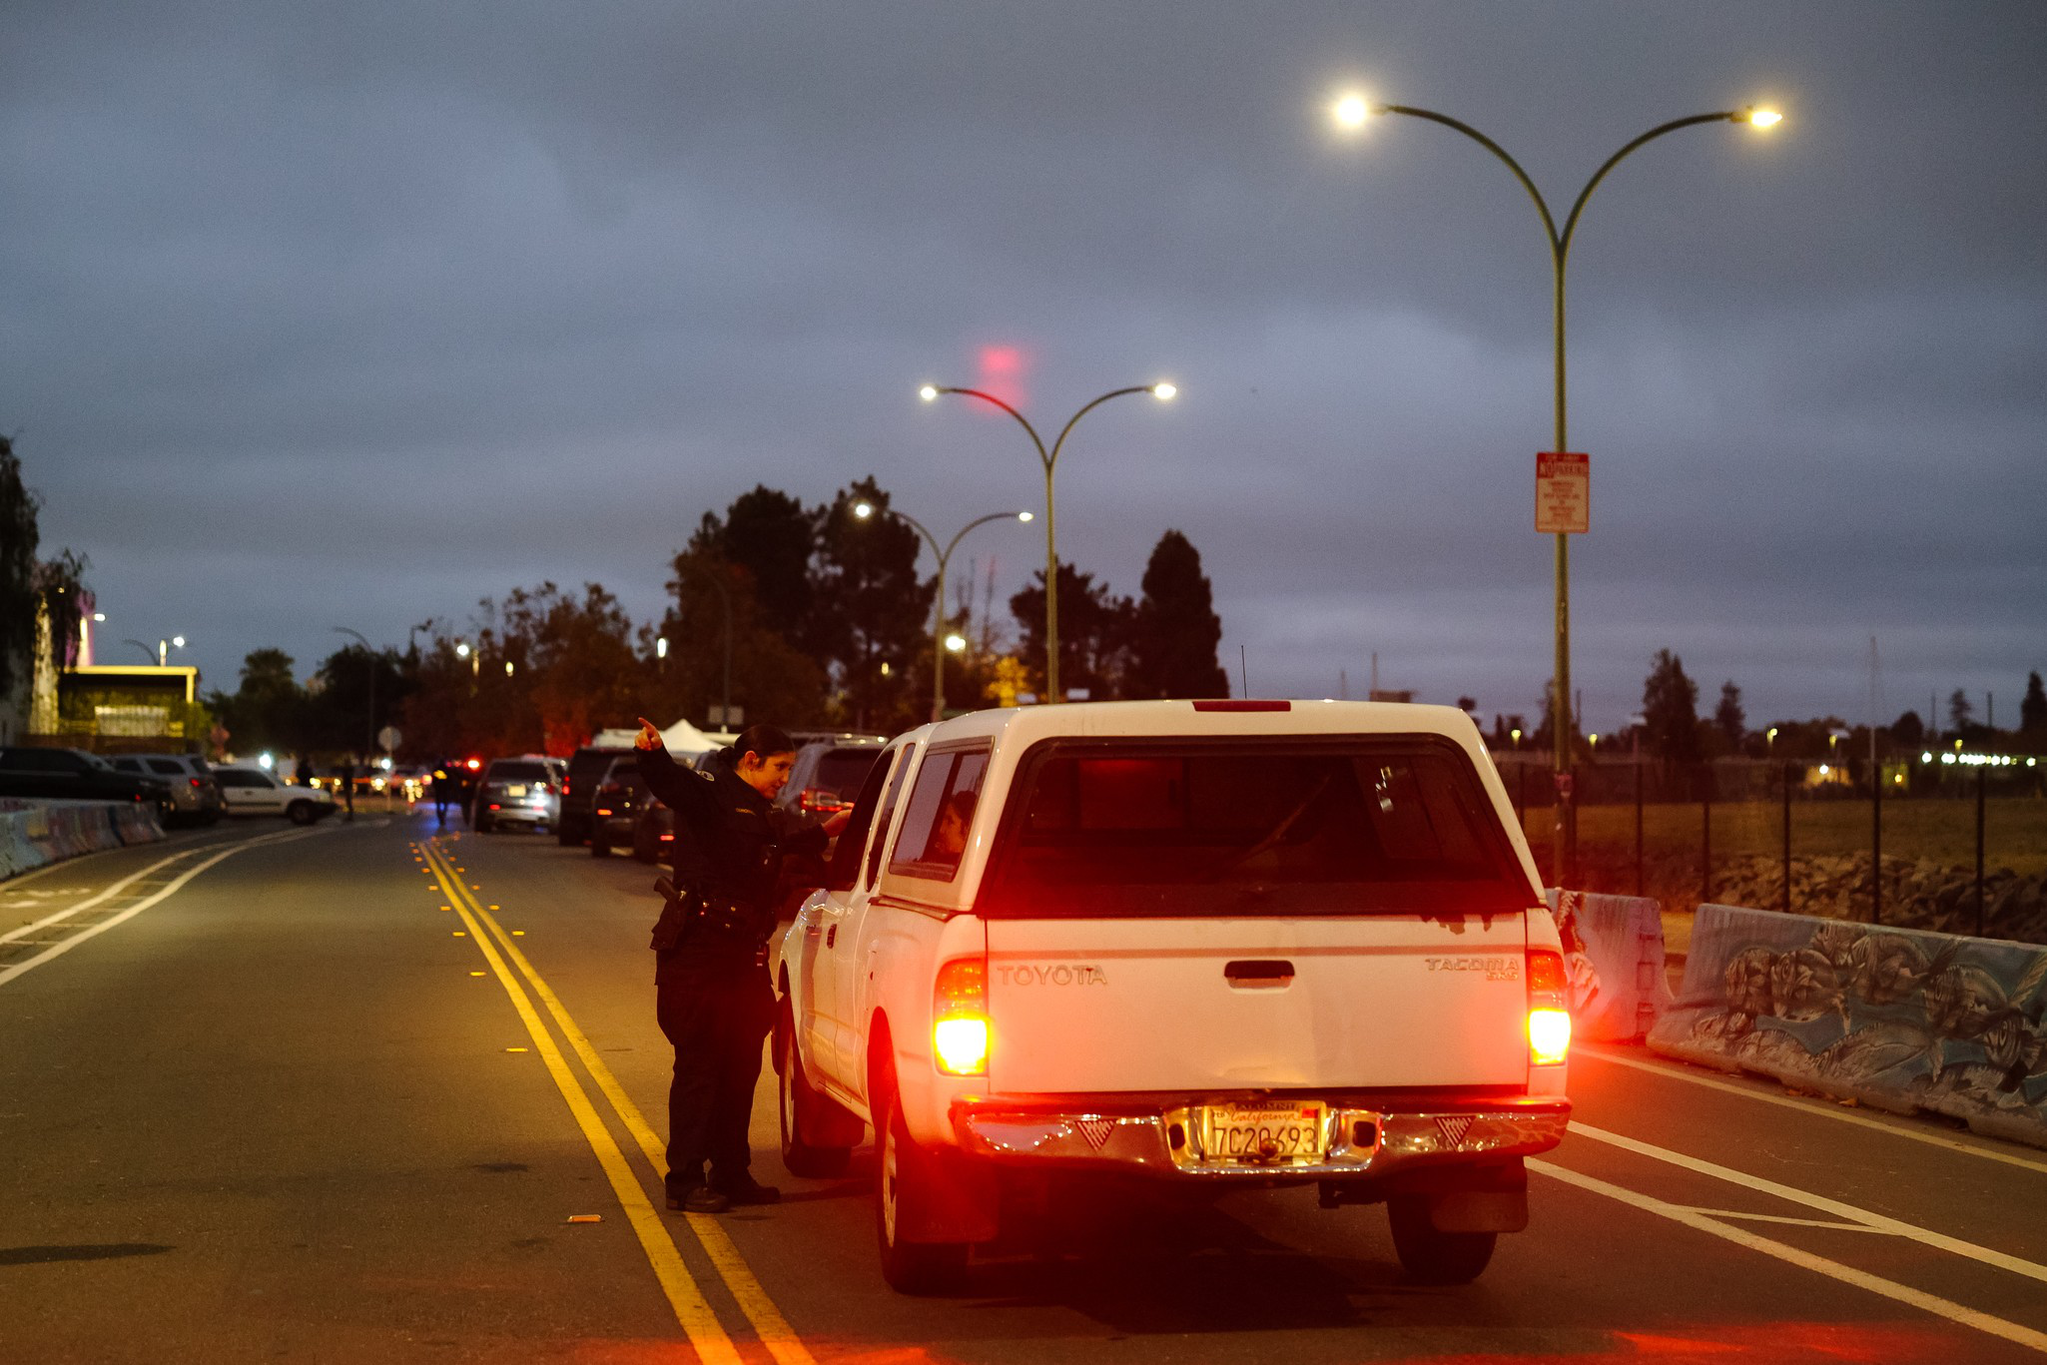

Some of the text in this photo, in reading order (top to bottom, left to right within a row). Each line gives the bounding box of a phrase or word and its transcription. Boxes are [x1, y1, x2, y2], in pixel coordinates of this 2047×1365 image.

[1425, 958, 1519, 971] TACOMA
[997, 964, 1107, 985] TOYOTA
[1230, 1109, 1301, 1124] California
